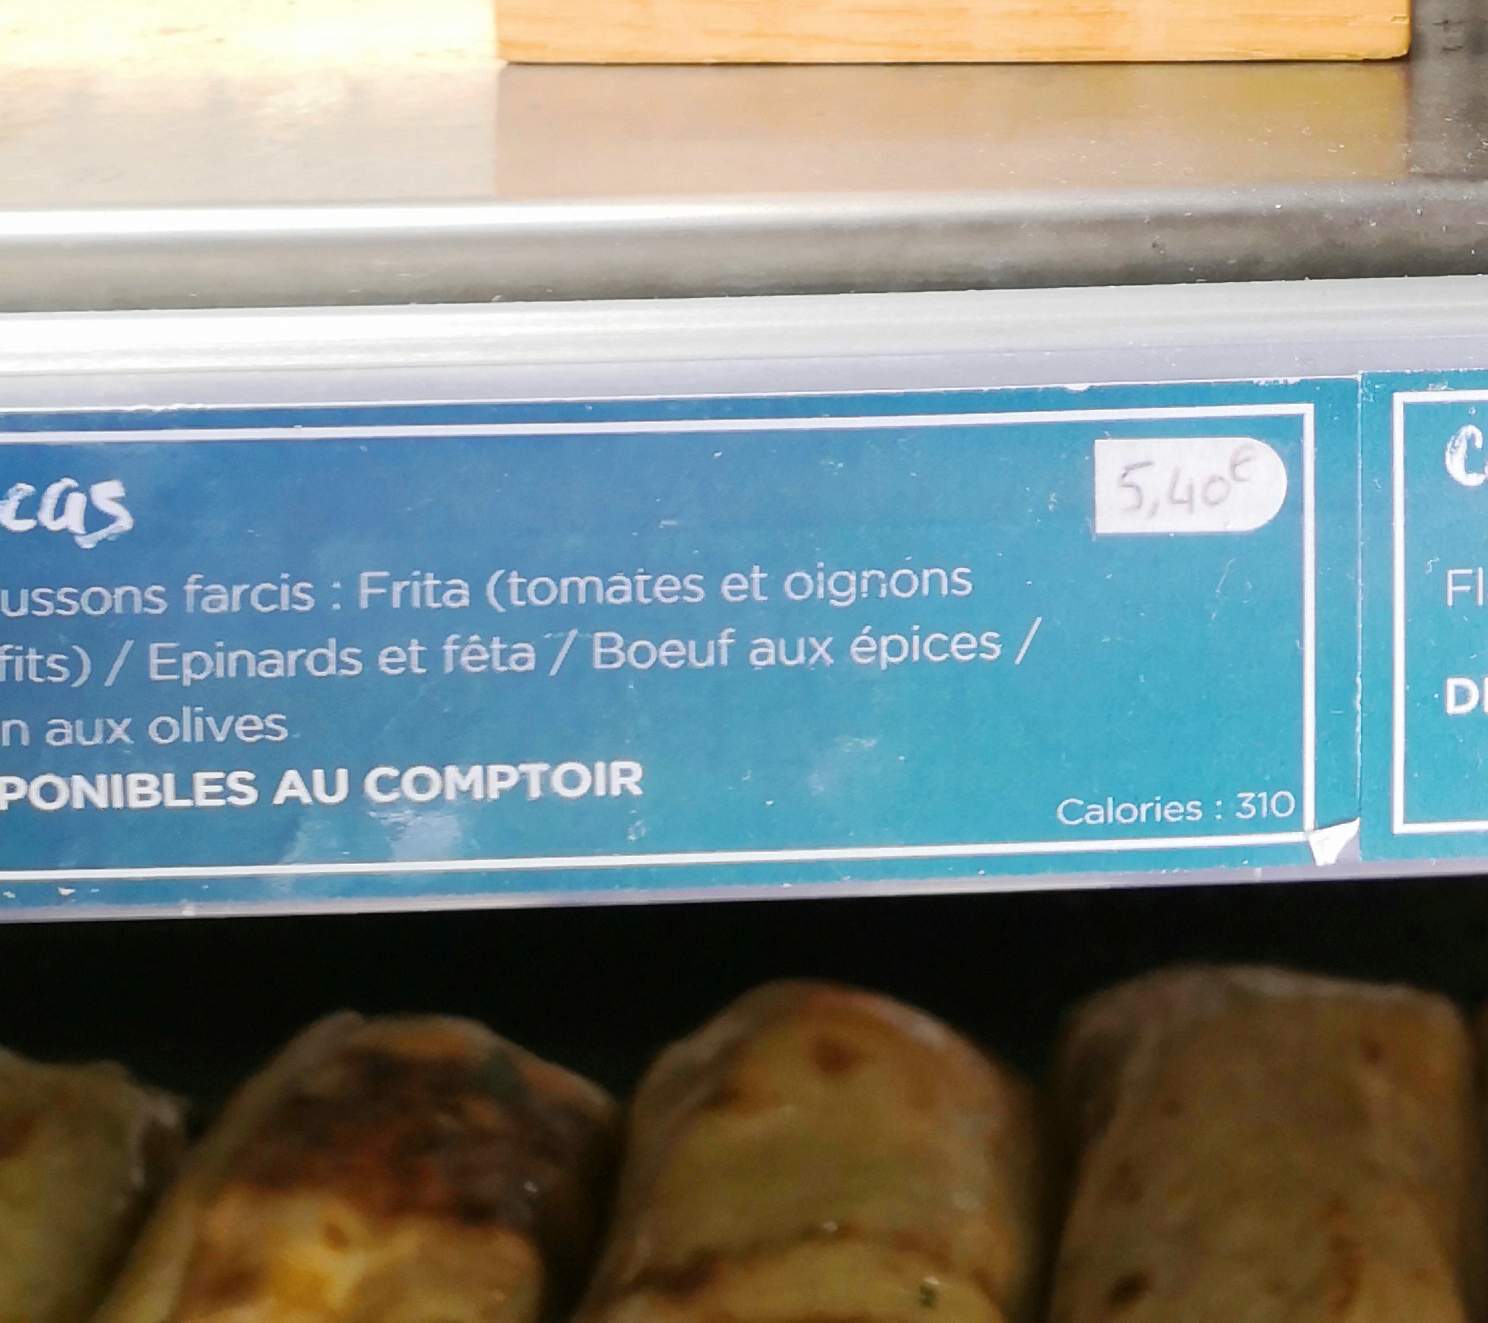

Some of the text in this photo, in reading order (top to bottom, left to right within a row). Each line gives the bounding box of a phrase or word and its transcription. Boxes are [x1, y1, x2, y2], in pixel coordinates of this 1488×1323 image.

[0, 584, 167, 617] ussons
[185, 574, 315, 615] farcis
[359, 570, 471, 611] Frita
[486, 568, 704, 612] (tomates
[721, 565, 768, 602] et
[784, 562, 974, 607] oignons
[148, 638, 363, 687] Epinards
[378, 637, 426, 675] et
[593, 629, 736, 670] Boeuf
[750, 638, 834, 667] aux
[850, 626, 1001, 673] épices
[46, 716, 134, 747] aux
[148, 707, 289, 744] olives
[0, 760, 643, 812] PONIBLES AU COMPTOIR
[1057, 795, 1203, 828] Calories
[1236, 790, 1295, 820] 310
